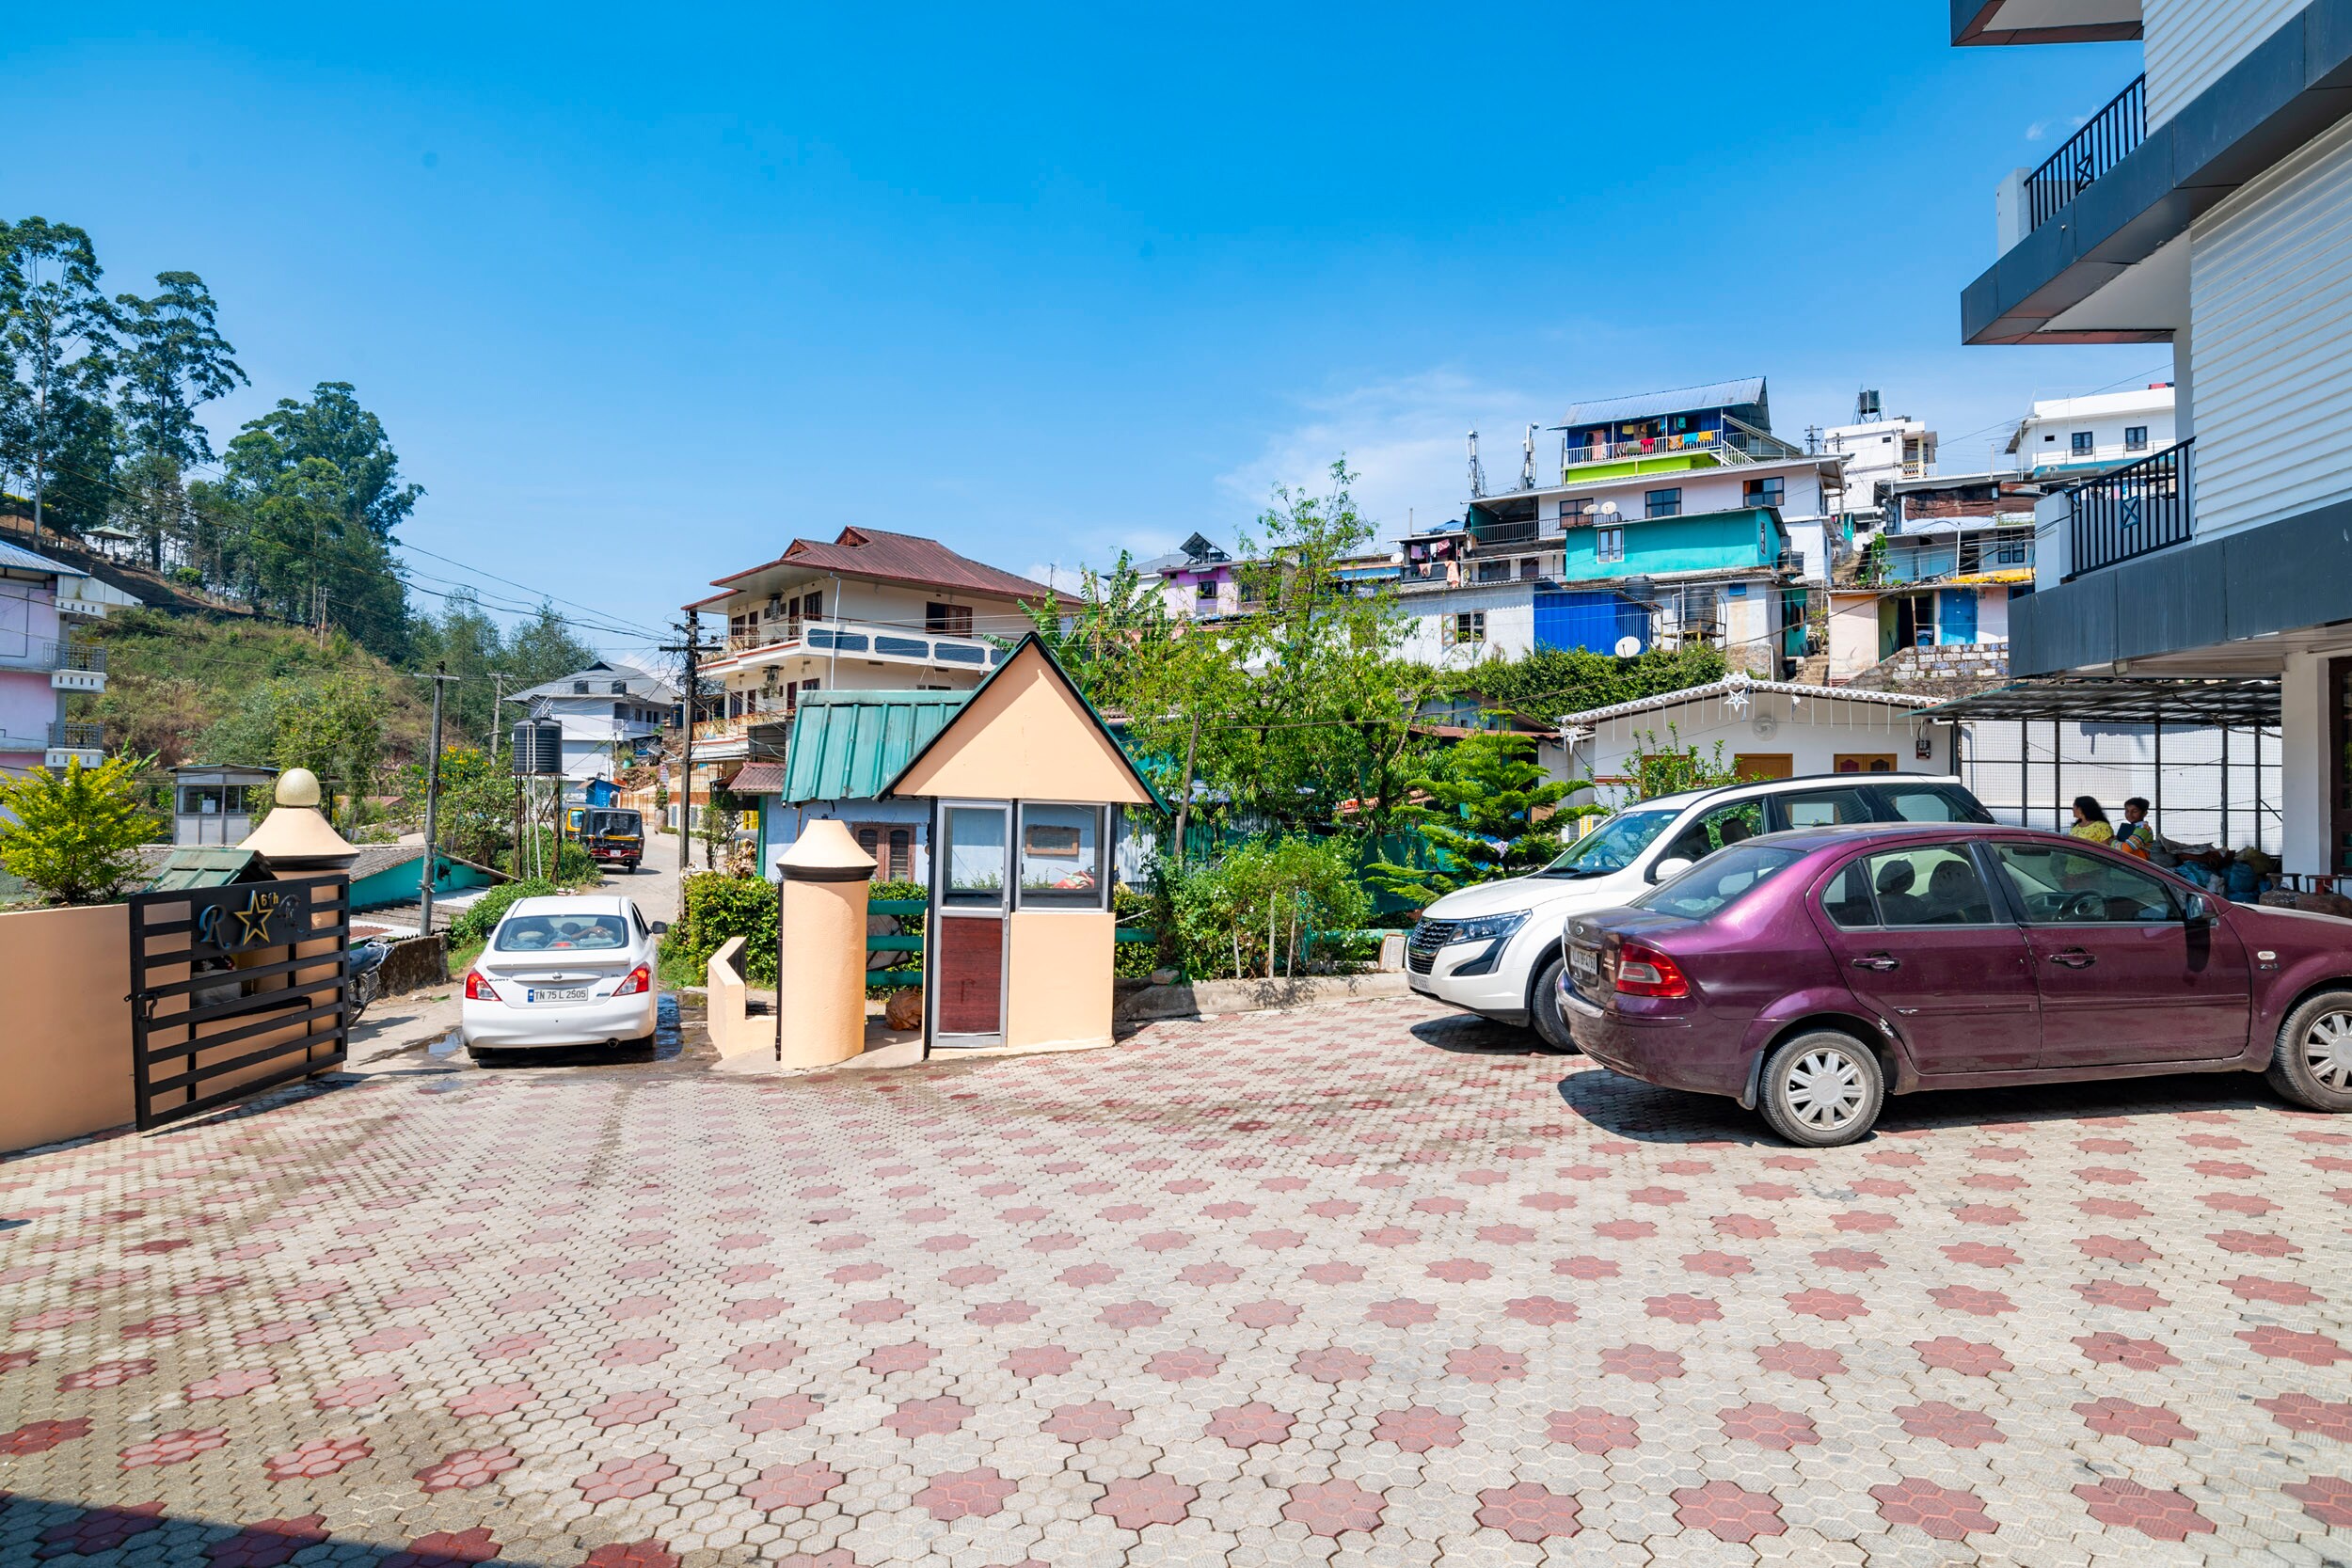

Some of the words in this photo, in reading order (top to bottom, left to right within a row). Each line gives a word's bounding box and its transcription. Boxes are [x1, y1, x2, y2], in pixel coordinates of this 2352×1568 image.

[199, 904, 232, 950] R
[535, 990, 545, 1000] TN
[547, 990, 557, 1000] 75
[559, 990, 564, 999] L
[565, 990, 586, 999] 2505
